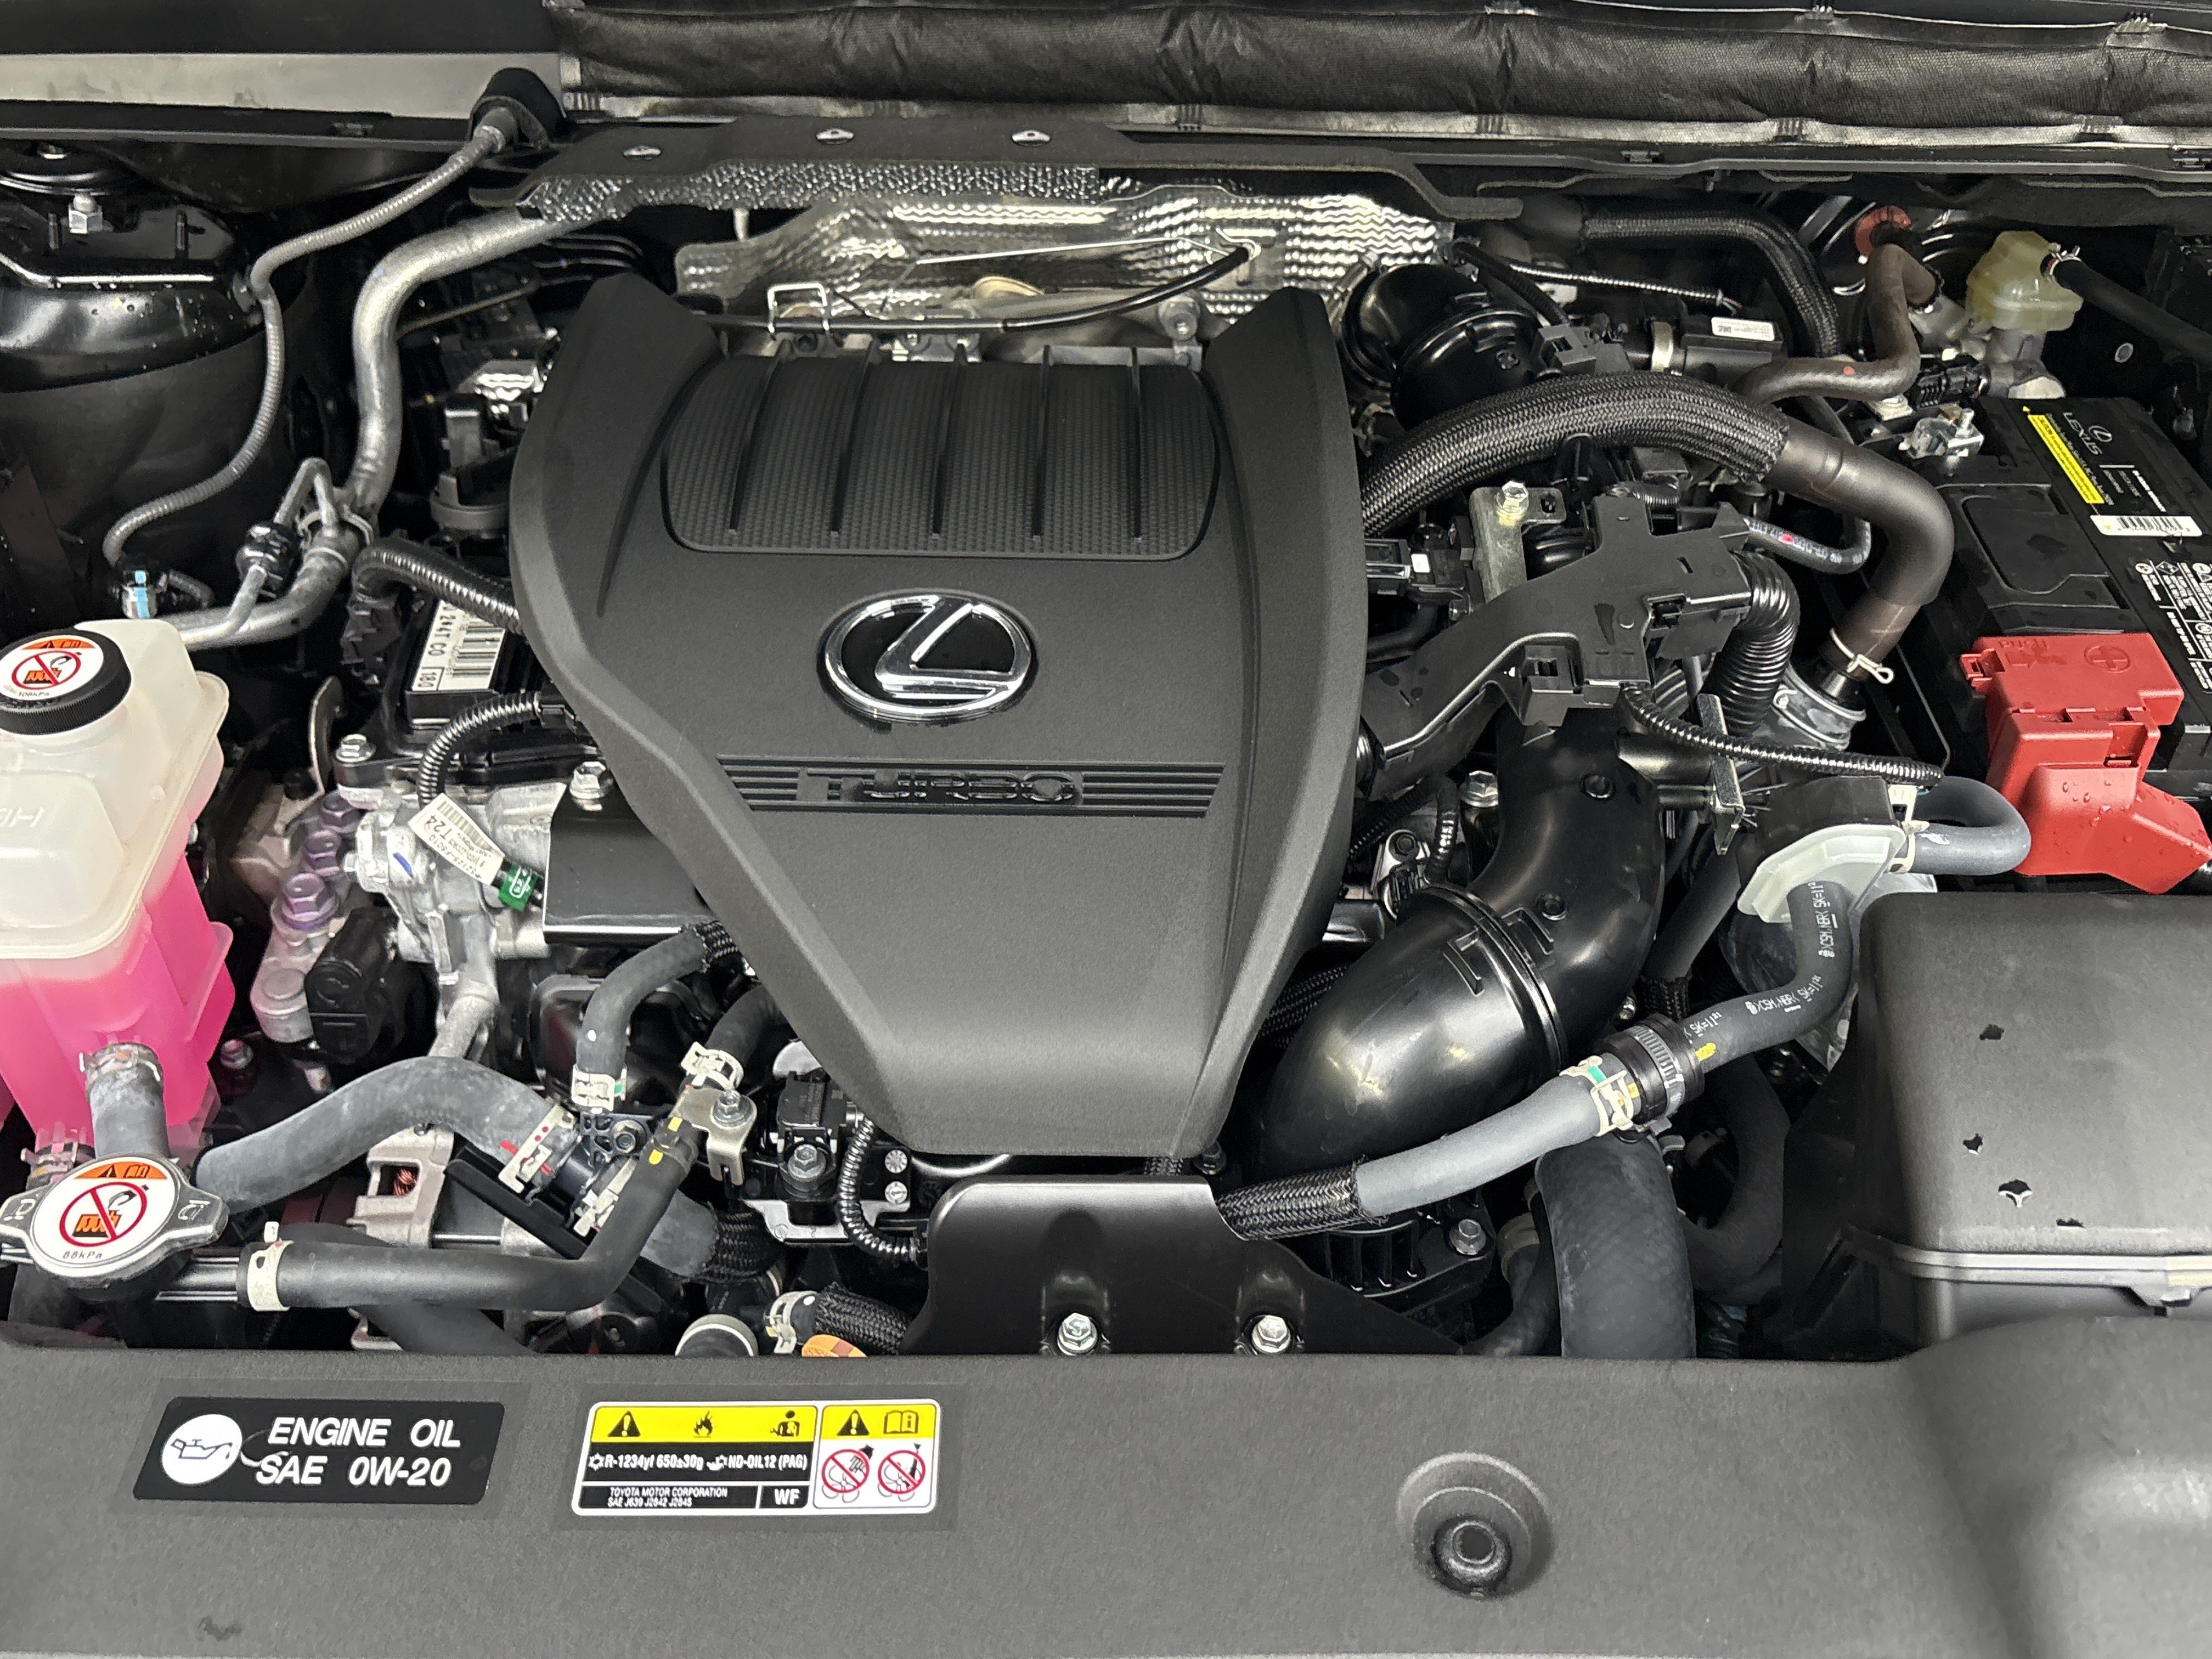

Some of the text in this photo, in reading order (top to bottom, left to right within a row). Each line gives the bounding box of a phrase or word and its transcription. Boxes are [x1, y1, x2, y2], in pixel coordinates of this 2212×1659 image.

[2063, 412, 2103, 455] LEXUS
[805, 769, 1074, 802] TURBO
[268, 1417, 461, 1448] ENGINE OIL
[255, 1455, 452, 1487] SAE 0W-20
[605, 1454, 655, 1471] R-1234yf
[656, 1454, 704, 1471] 650±30g
[778, 1454, 808, 1471] (PAG)
[607, 1497, 623, 1508] SAE
[610, 1487, 728, 1498] TOYOTA MOTOR CORPORATION
[774, 1488, 800, 1505] WF
